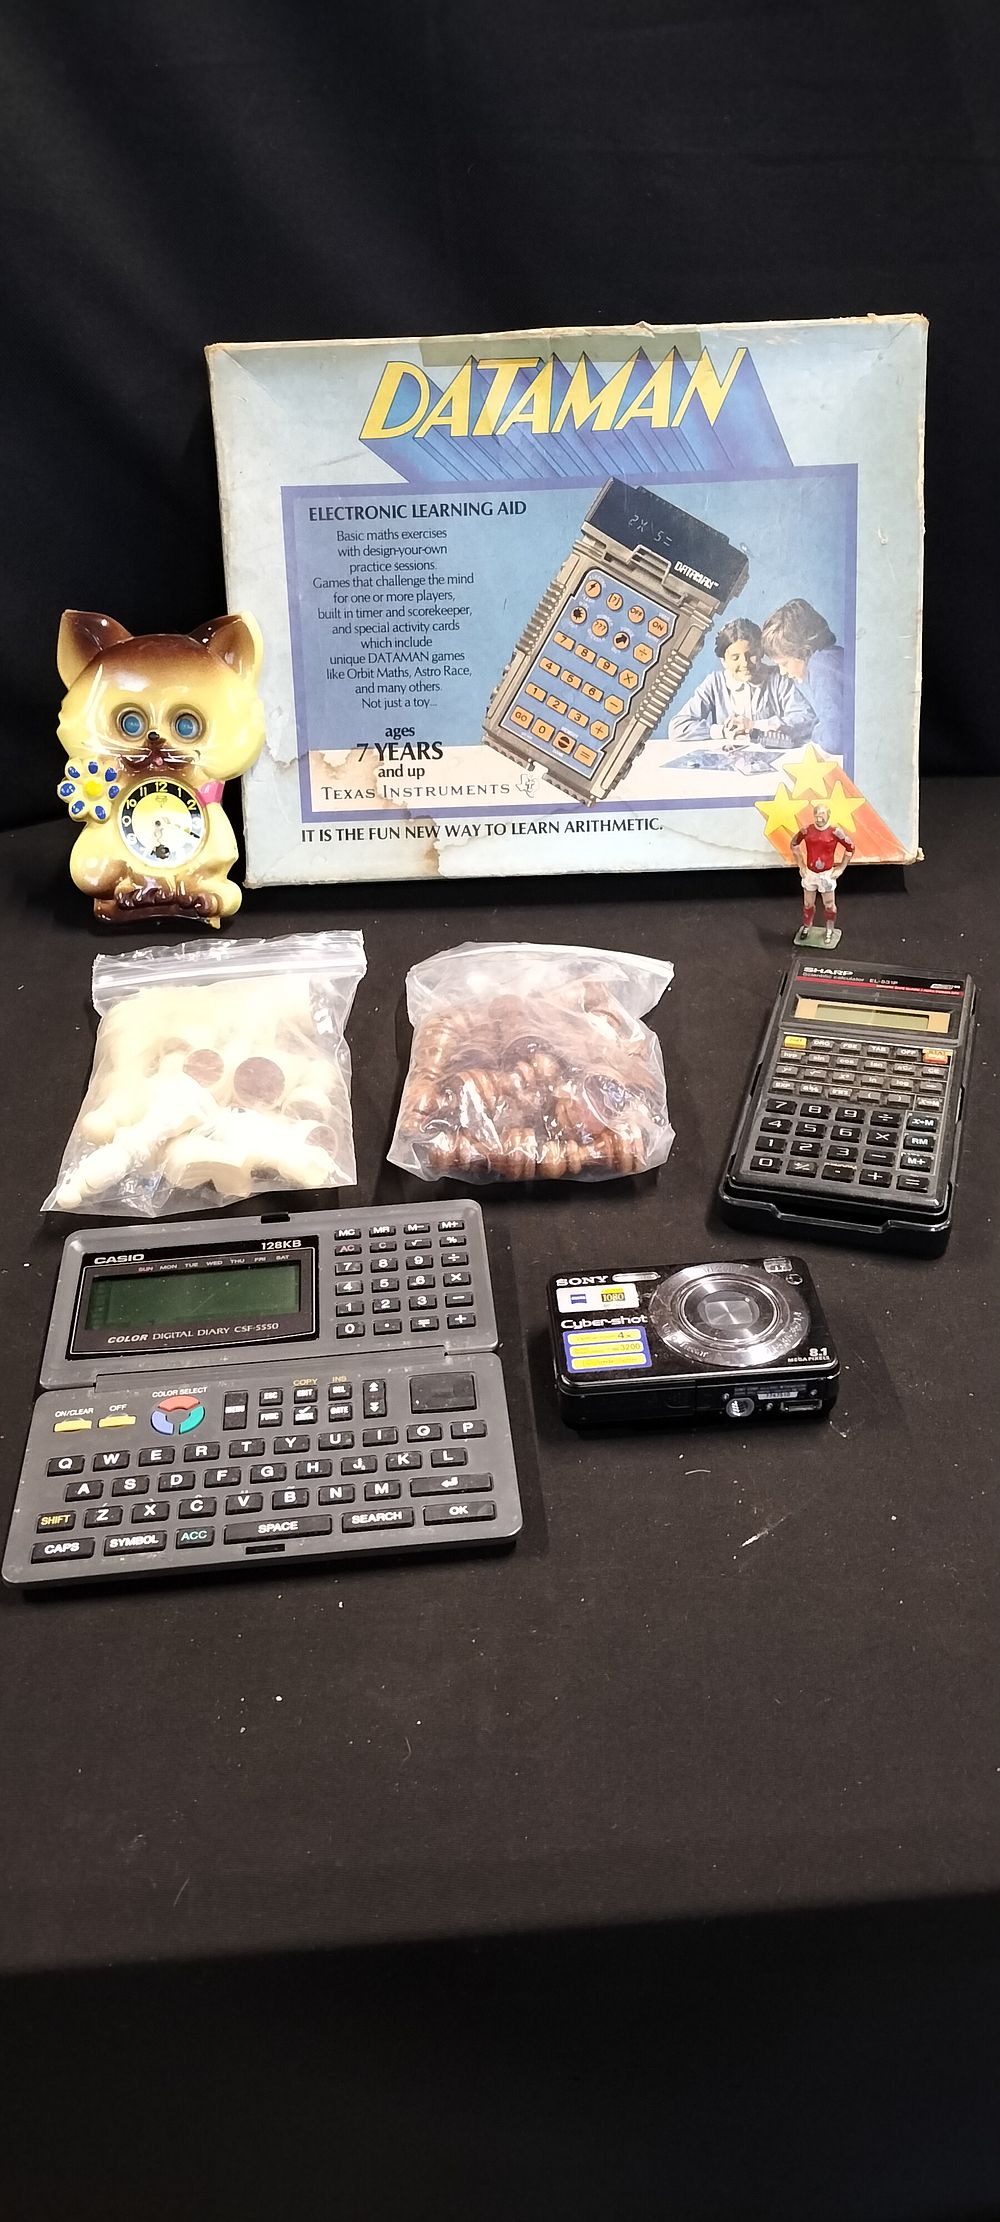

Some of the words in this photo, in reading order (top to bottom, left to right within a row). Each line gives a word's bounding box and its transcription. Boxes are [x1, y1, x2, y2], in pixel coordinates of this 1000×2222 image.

[359, 347, 747, 440] DATAMAN
[309, 505, 408, 521] ELECTRONIC
[412, 501, 493, 518] LEARNING
[497, 501, 527, 515] AID
[337, 530, 364, 541] Basic
[367, 528, 399, 540] maths
[402, 529, 447, 539] exercises
[338, 546, 360, 557] with
[363, 545, 447, 558] design-your-own
[350, 562, 391, 574] practice
[313, 577, 350, 588] Games
[353, 576, 373, 588] that
[376, 575, 425, 588] challenge
[428, 575, 445, 585] the
[447, 573, 474, 584] mind
[334, 593, 348, 603] for
[351, 595, 370, 603] one
[387, 593, 414, 601] more
[417, 590, 455, 602] players,
[318, 608, 342, 619] built
[344, 610, 353, 618] in
[356, 608, 383, 618] timer
[386, 606, 405, 617] and
[408, 604, 472, 617] scorekeeper,
[332, 623, 351, 634] and
[354, 622, 390, 635] special
[393, 621, 430, 633] activity
[432, 619, 460, 631] cards
[652, 621, 663, 631] ON
[361, 637, 392, 648] which
[394, 635, 432, 647] include
[330, 655, 366, 666] unique
[368, 652, 429, 663] DATAMAN
[432, 651, 465, 664] games
[326, 669, 345, 679] like
[347, 668, 374, 679] Orbit
[376, 667, 411, 678] Maths,
[414, 667, 441, 677] Astro
[444, 665, 472, 676] Race,
[355, 682, 375, 694] and
[377, 684, 406, 694] many
[362, 698, 381, 708] Not
[383, 698, 401, 710] just
[405, 699, 410, 707] a
[385, 726, 415, 740] ages
[357, 743, 368, 762] 7
[374, 741, 443, 761] YEARS
[378, 765, 403, 778] and
[408, 767, 425, 779] up
[140, 786, 147, 797] 11
[155, 782, 168, 792] 12
[126, 799, 137, 809] 10
[187, 800, 197, 810] 2
[302, 829, 315, 842] IT
[320, 829, 332, 841] IS
[336, 828, 364, 841] THE
[369, 827, 400, 840] FUN
[405, 825, 440, 839] NEW
[445, 824, 481, 838] WAY
[485, 823, 506, 836] TO
[512, 821, 560, 835] LEARN
[565, 818, 663, 833] ARITHMETIC.
[803, 967, 854, 976] SHARP
[373, 1226, 390, 1234] MR
[261, 1240, 302, 1250] 128KB
[340, 1245, 355, 1253] AC
[94, 1254, 145, 1265] CASIO
[344, 1262, 352, 1270] 7
[379, 1259, 387, 1268] 8
[414, 1256, 423, 1264] 9
[344, 1282, 352, 1290] 4
[380, 1279, 389, 1287] 5
[416, 1276, 425, 1284] 6
[556, 1276, 608, 1286] SONY
[381, 1300, 390, 1309] 2
[417, 1296, 427, 1305] 3
[602, 1293, 625, 1302] 1080
[560, 1314, 648, 1329] Cyber-shot
[107, 1334, 148, 1344] COLOR
[152, 1331, 194, 1340] DIGITAL
[197, 1327, 230, 1336] DIARY
[234, 1323, 279, 1332] CSF-5550
[345, 1324, 355, 1333] 0
[809, 1348, 828, 1357] 8.1
[293, 1378, 318, 1386] COPY
[152, 1390, 179, 1398] COLOR
[179, 1387, 208, 1395] SELECT
[55, 1408, 94, 1418] ON/CLEAR
[109, 1404, 127, 1412] OFF
[58, 1458, 72, 1469] Q
[103, 1454, 120, 1465] W
[151, 1450, 162, 1460] E
[196, 1445, 207, 1456] R
[242, 1441, 252, 1451] T
[285, 1438, 296, 1448] Y
[330, 1434, 342, 1444] U
[463, 1422, 474, 1432] P
[77, 1484, 90, 1494] A
[124, 1478, 136, 1490] S
[170, 1474, 183, 1485] D
[217, 1470, 228, 1482] F
[261, 1466, 274, 1477] G
[307, 1462, 319, 1473] H
[398, 1454, 410, 1465] K
[443, 1450, 453, 1461] L
[41, 1515, 71, 1526] SHIFT
[330, 1487, 342, 1498] N
[374, 1483, 389, 1494] M
[44, 1542, 80, 1554] CAPS
[109, 1535, 159, 1548] SYMBOL
[180, 1531, 207, 1541] ACC
[258, 1521, 299, 1534] SPACE
[352, 1512, 402, 1524] SEARCH
[449, 1505, 468, 1515] OK
